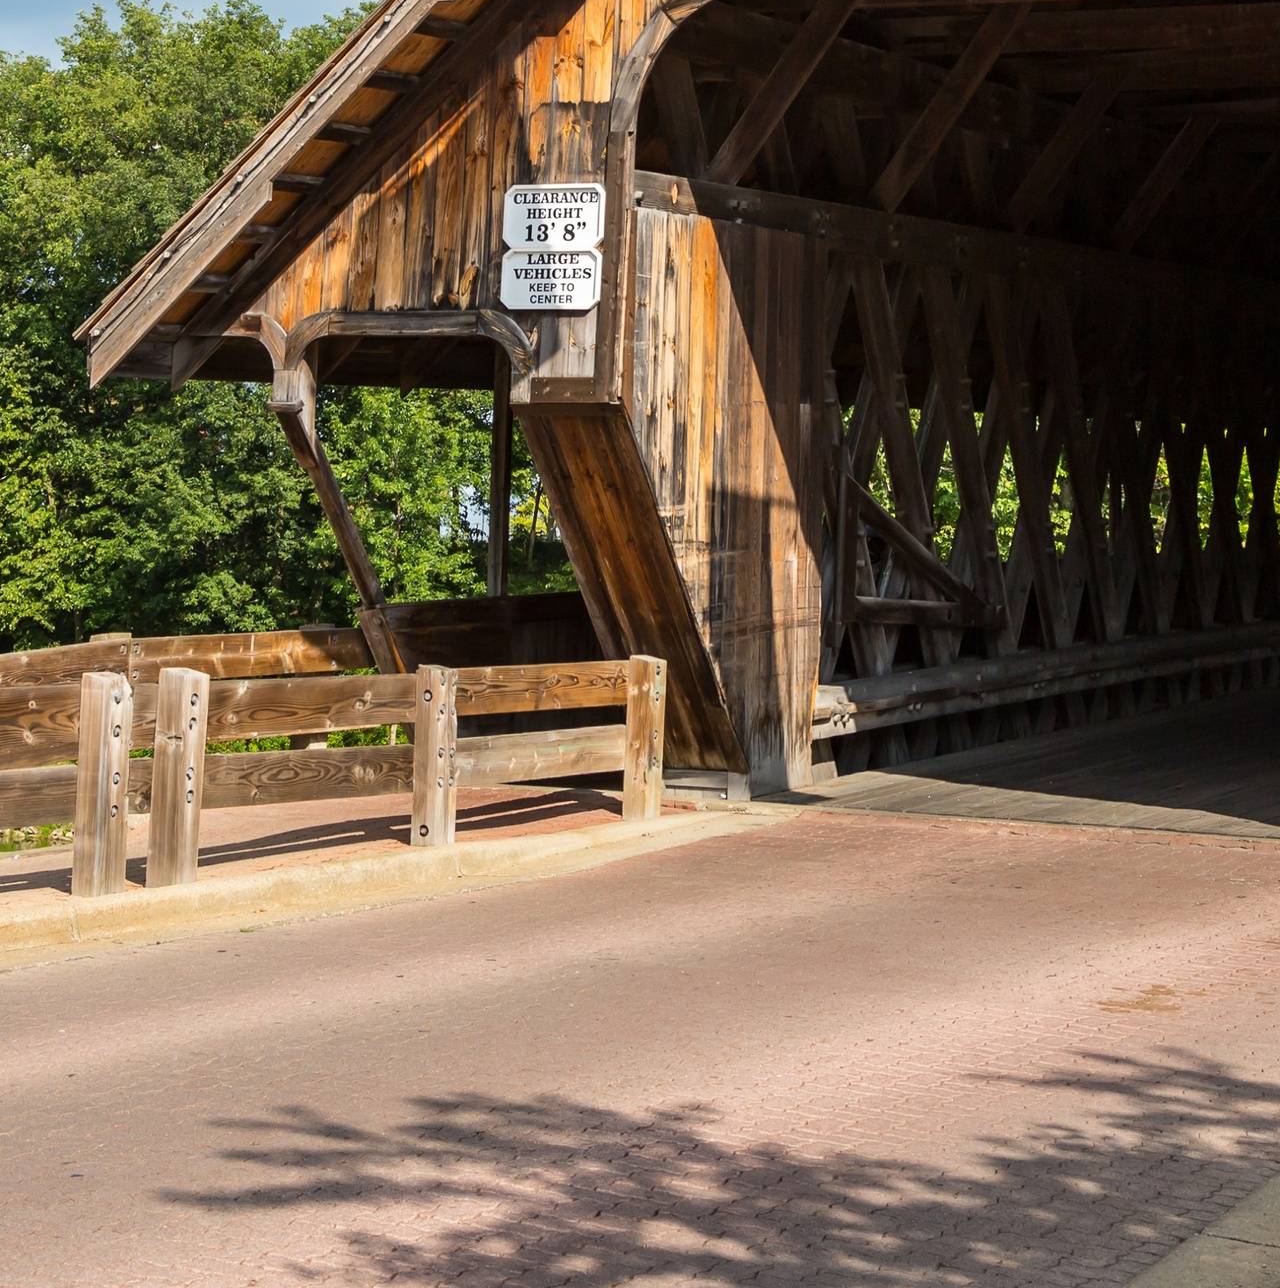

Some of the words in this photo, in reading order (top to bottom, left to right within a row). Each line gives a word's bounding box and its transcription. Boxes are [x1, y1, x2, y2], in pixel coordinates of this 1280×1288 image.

[513, 191, 599, 205] CLEARANCE
[526, 207, 583, 220] HEIGHT
[527, 253, 580, 265] LARGE
[513, 267, 592, 280] VEHICLES
[529, 282, 557, 292] KEEP
[561, 282, 575, 292] TO
[529, 294, 573, 304] CENTER
